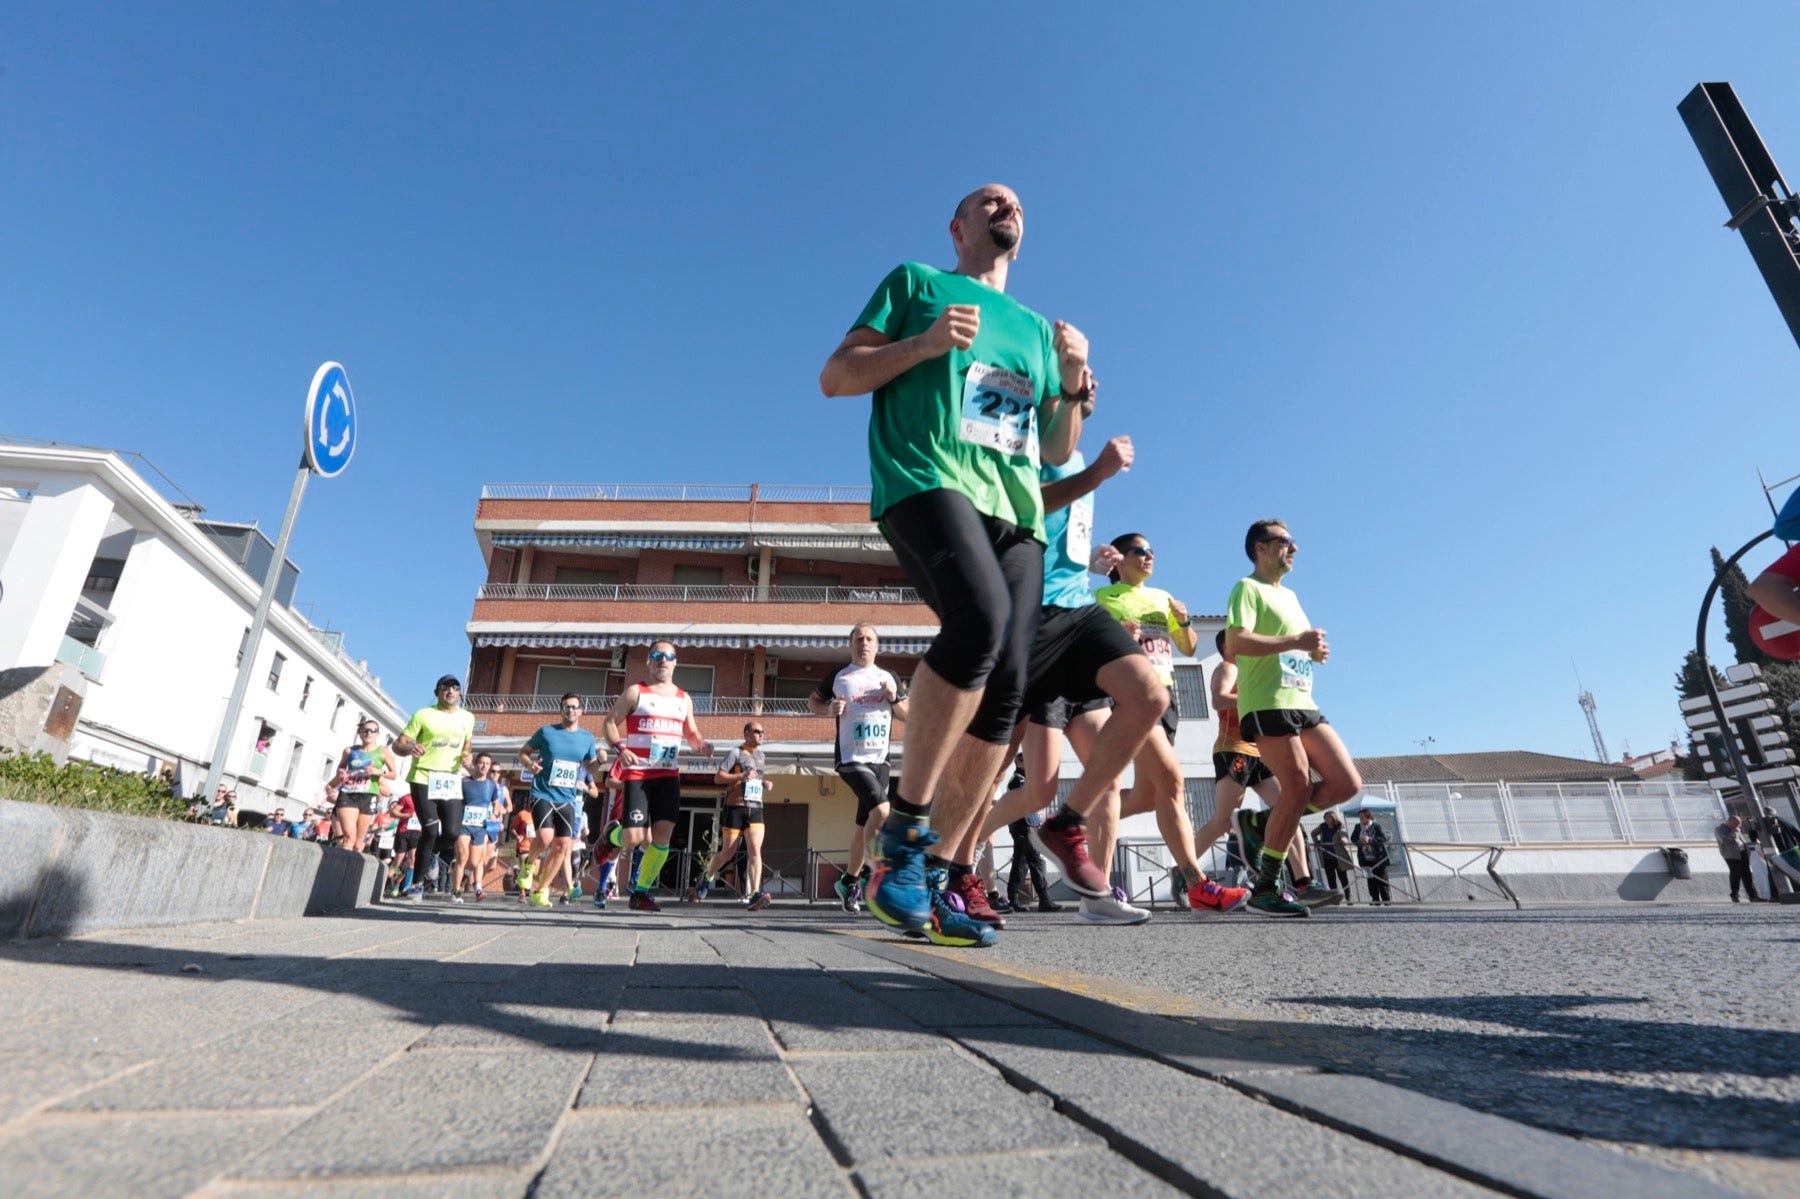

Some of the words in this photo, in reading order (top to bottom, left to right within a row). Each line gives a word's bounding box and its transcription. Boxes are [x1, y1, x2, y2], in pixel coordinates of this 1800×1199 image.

[855, 724, 887, 738] 1105
[662, 746, 676, 759] 75
[556, 768, 575, 780] 286
[467, 811, 483, 820] 357
